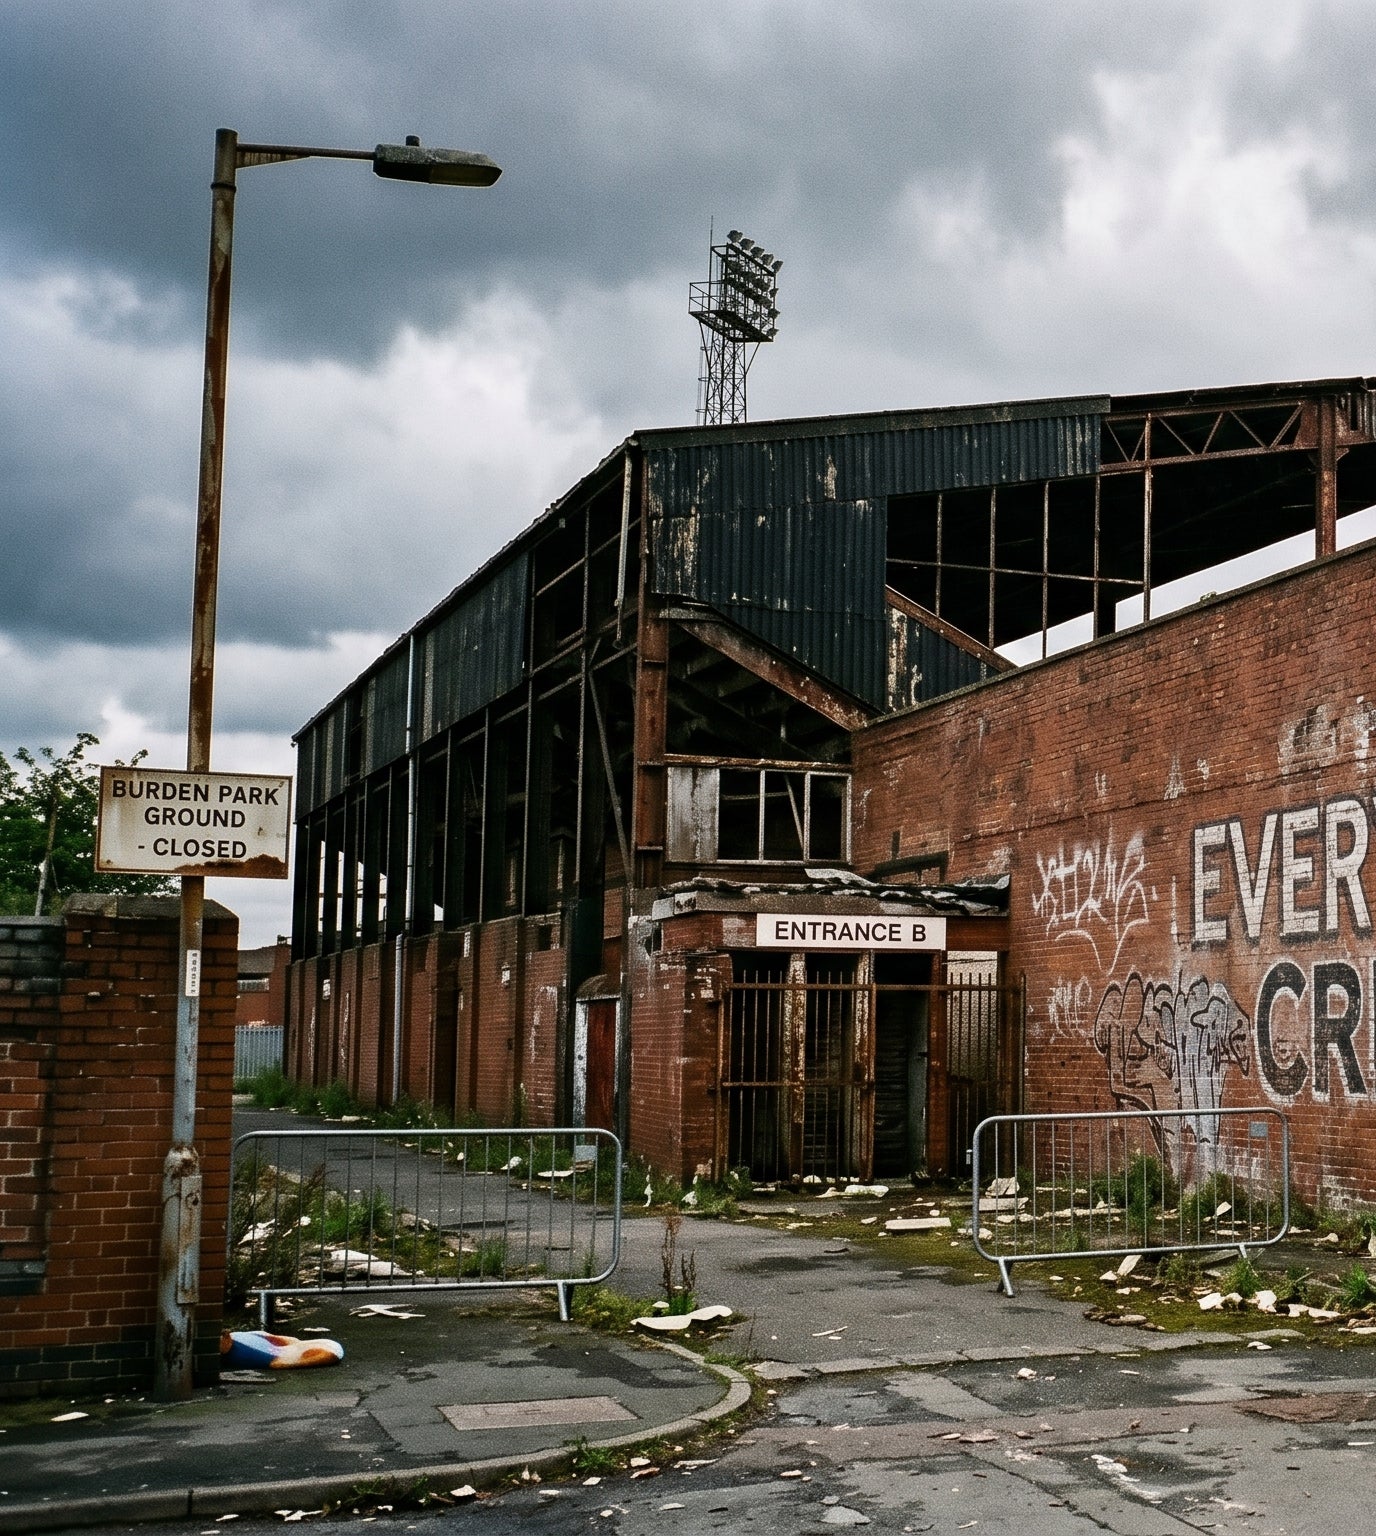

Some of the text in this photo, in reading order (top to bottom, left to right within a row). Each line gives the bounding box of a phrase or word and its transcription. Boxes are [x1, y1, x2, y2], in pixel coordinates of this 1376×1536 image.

[112, 779, 279, 806] BURDEN PARK
[144, 806, 246, 828] GROUND
[152, 838, 247, 858] CLOSED
[775, 920, 927, 942] ENTRANCE B
